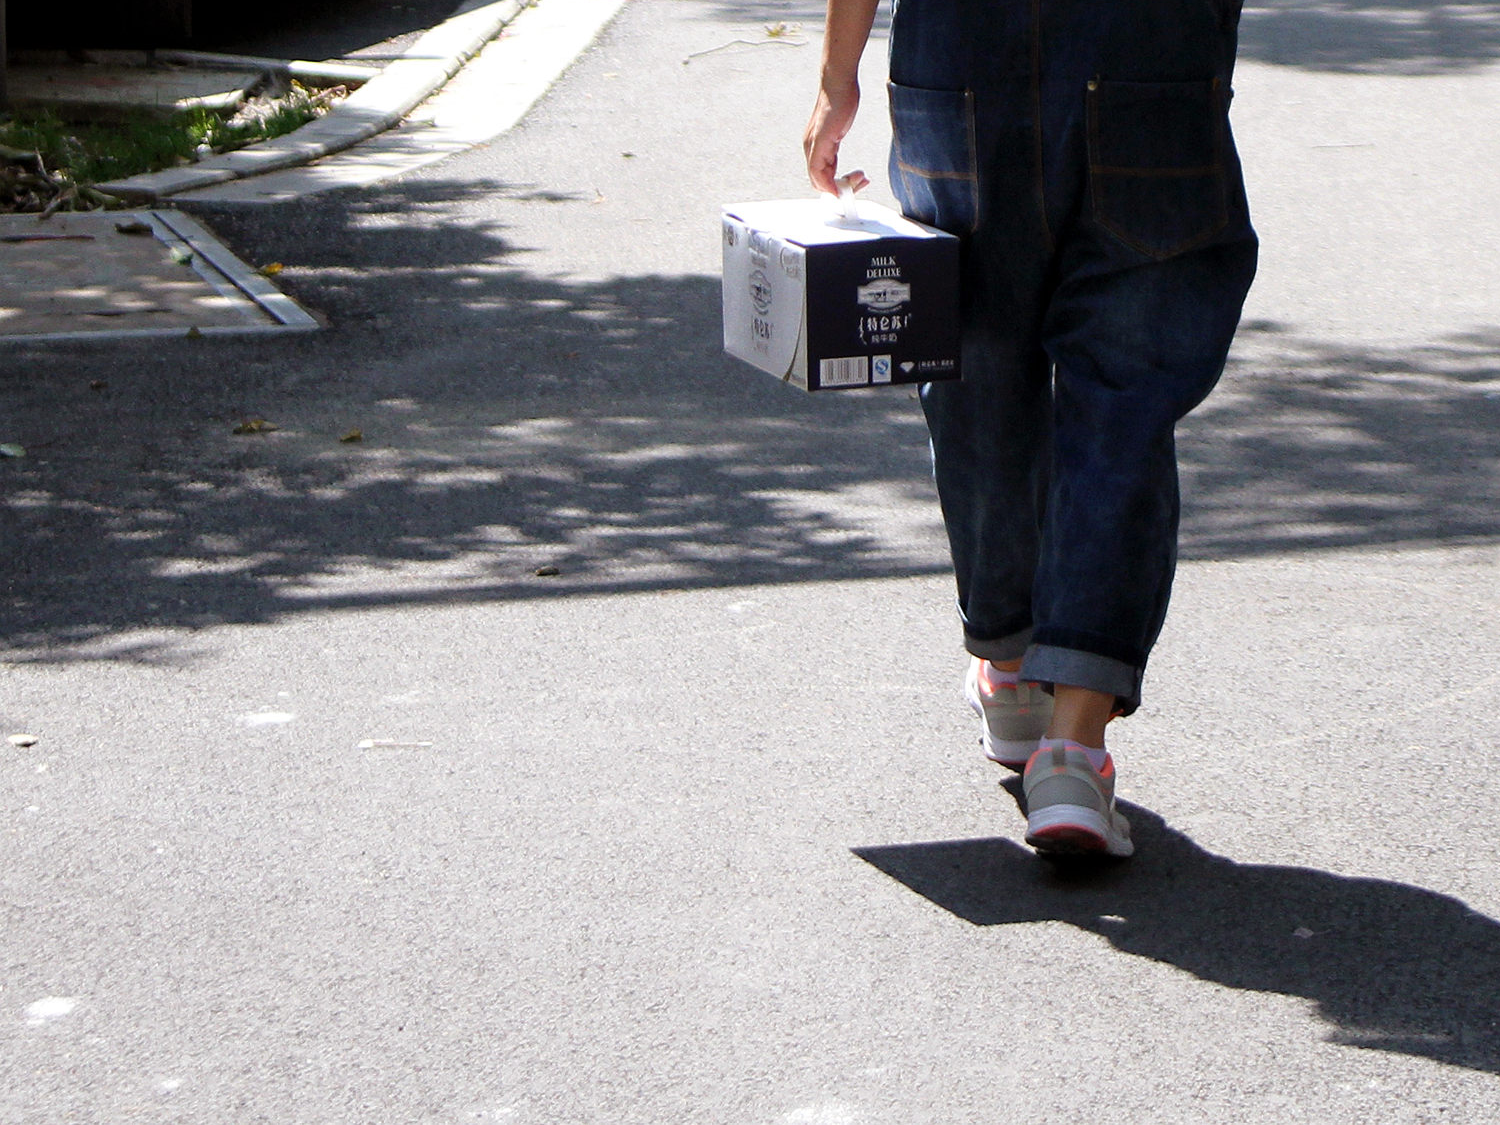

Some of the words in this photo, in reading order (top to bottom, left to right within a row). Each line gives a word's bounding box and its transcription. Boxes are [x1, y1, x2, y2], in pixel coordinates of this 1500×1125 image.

[871, 256, 897, 267] MILK
[866, 267, 901, 279] DELUXE
[867, 315, 902, 332] 特仑苏
